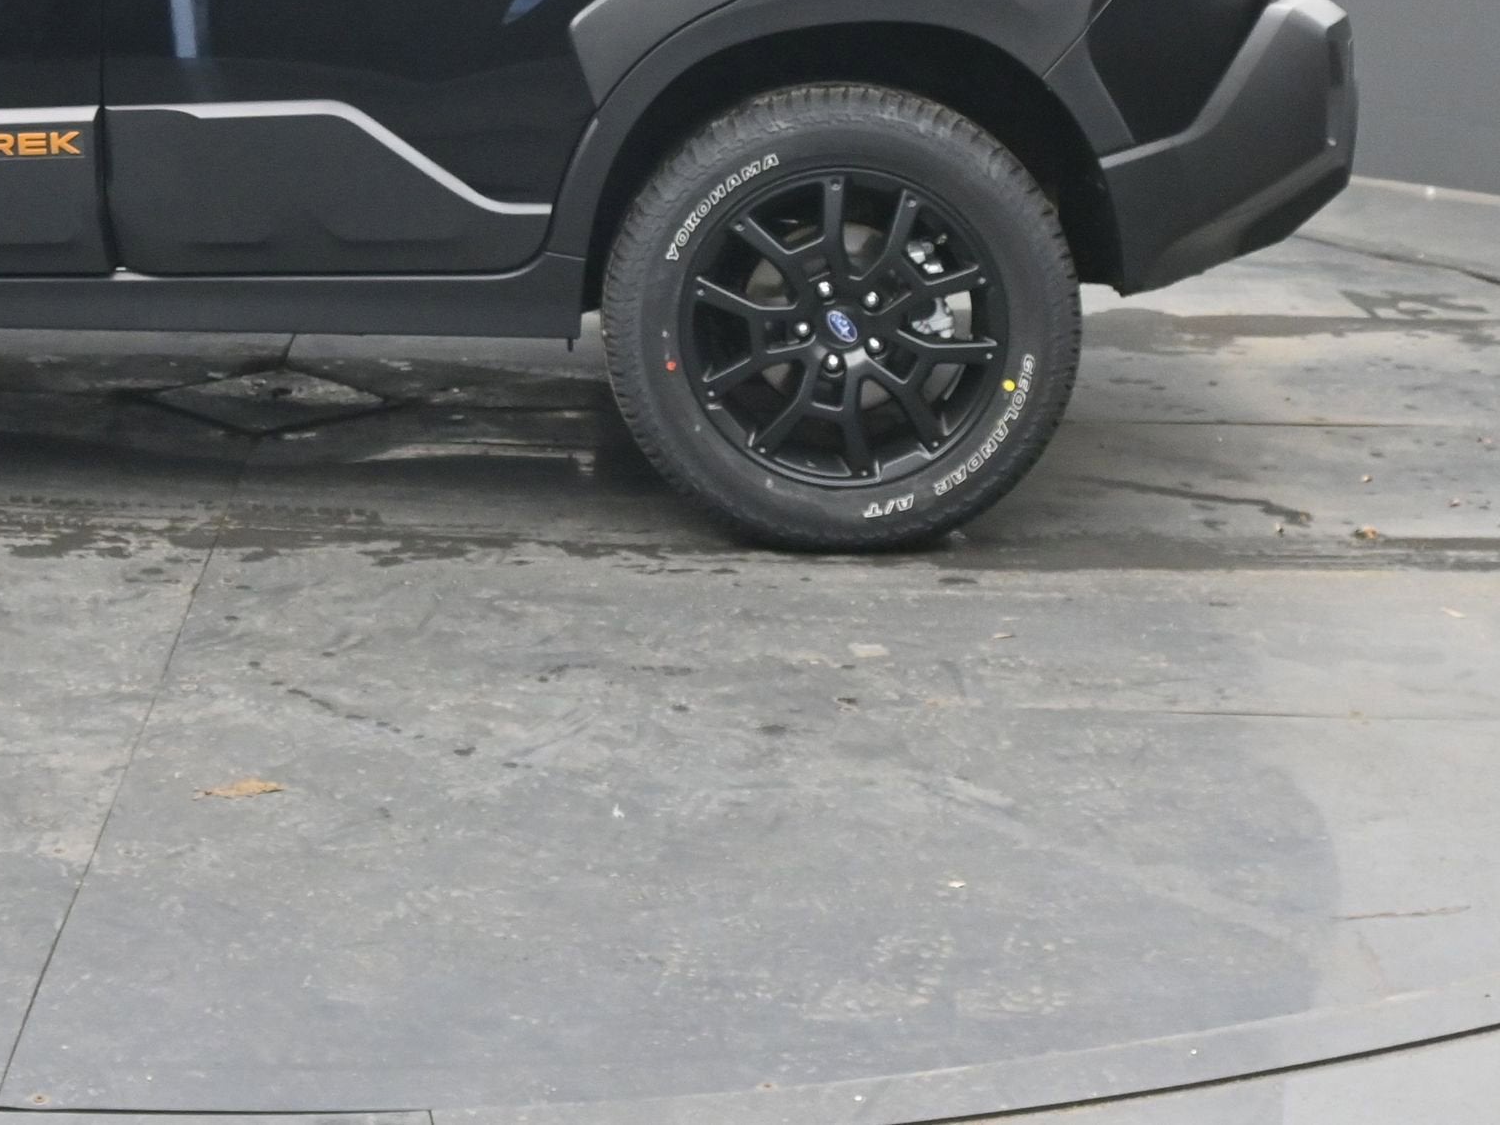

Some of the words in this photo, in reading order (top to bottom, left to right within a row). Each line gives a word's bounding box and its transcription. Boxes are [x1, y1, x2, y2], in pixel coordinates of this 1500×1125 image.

[665, 153, 780, 261] YOKOHAMA
[933, 353, 1036, 496] GEOLANDAR
[863, 493, 915, 518] A/T
